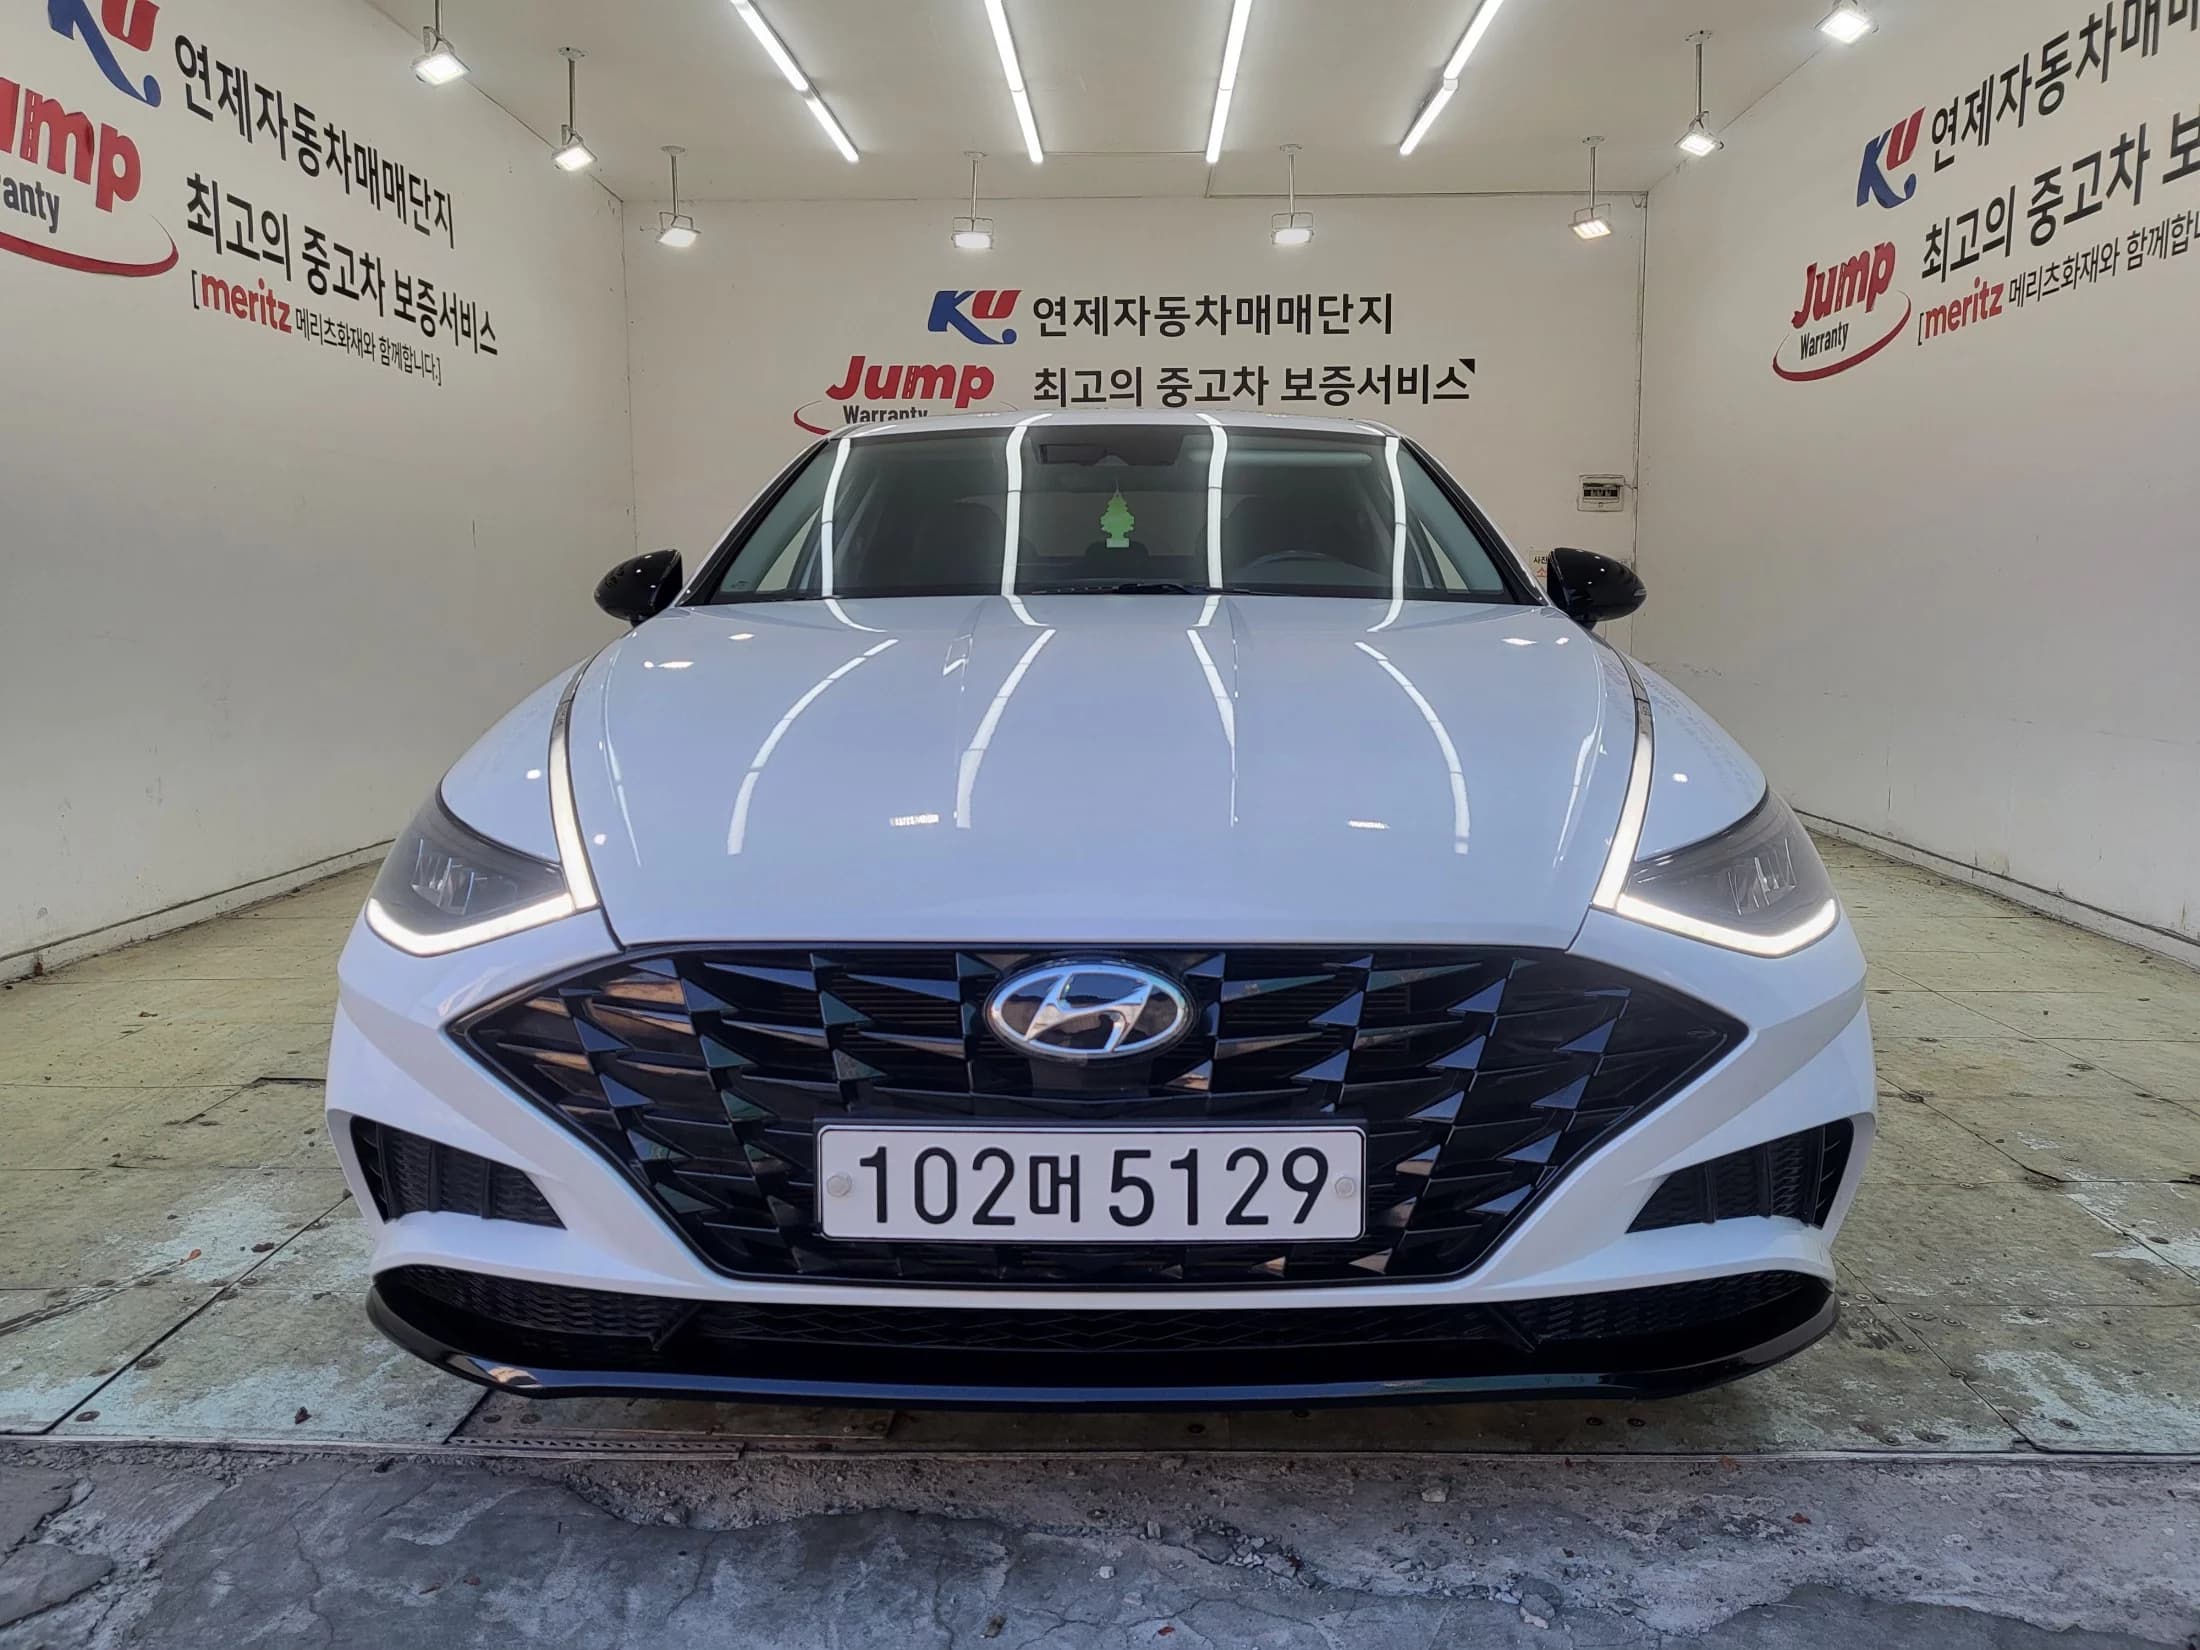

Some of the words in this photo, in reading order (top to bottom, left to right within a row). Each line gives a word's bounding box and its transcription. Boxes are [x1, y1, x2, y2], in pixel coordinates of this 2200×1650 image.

[175, 34, 454, 249] 연제자동차매매단지
[0, 174, 60, 233] anty
[1921, 185, 2016, 283] 최고의
[2026, 122, 2151, 247] 중고차
[186, 173, 291, 281] 최고의
[301, 225, 386, 317] 중고차
[394, 269, 498, 356] 보증서비스
[1791, 241, 1896, 329] Jump
[2008, 237, 2121, 307] 메리츠화재와
[295, 307, 377, 362] 메리츠화재와
[1032, 293, 1393, 337] 연제자동차매매단지
[1800, 321, 1849, 360] Warranty
[825, 355, 995, 409] Jump
[1033, 367, 1143, 407] 최고의
[1156, 365, 1269, 408] 중고차
[1280, 361, 1470, 406] 보증서비스
